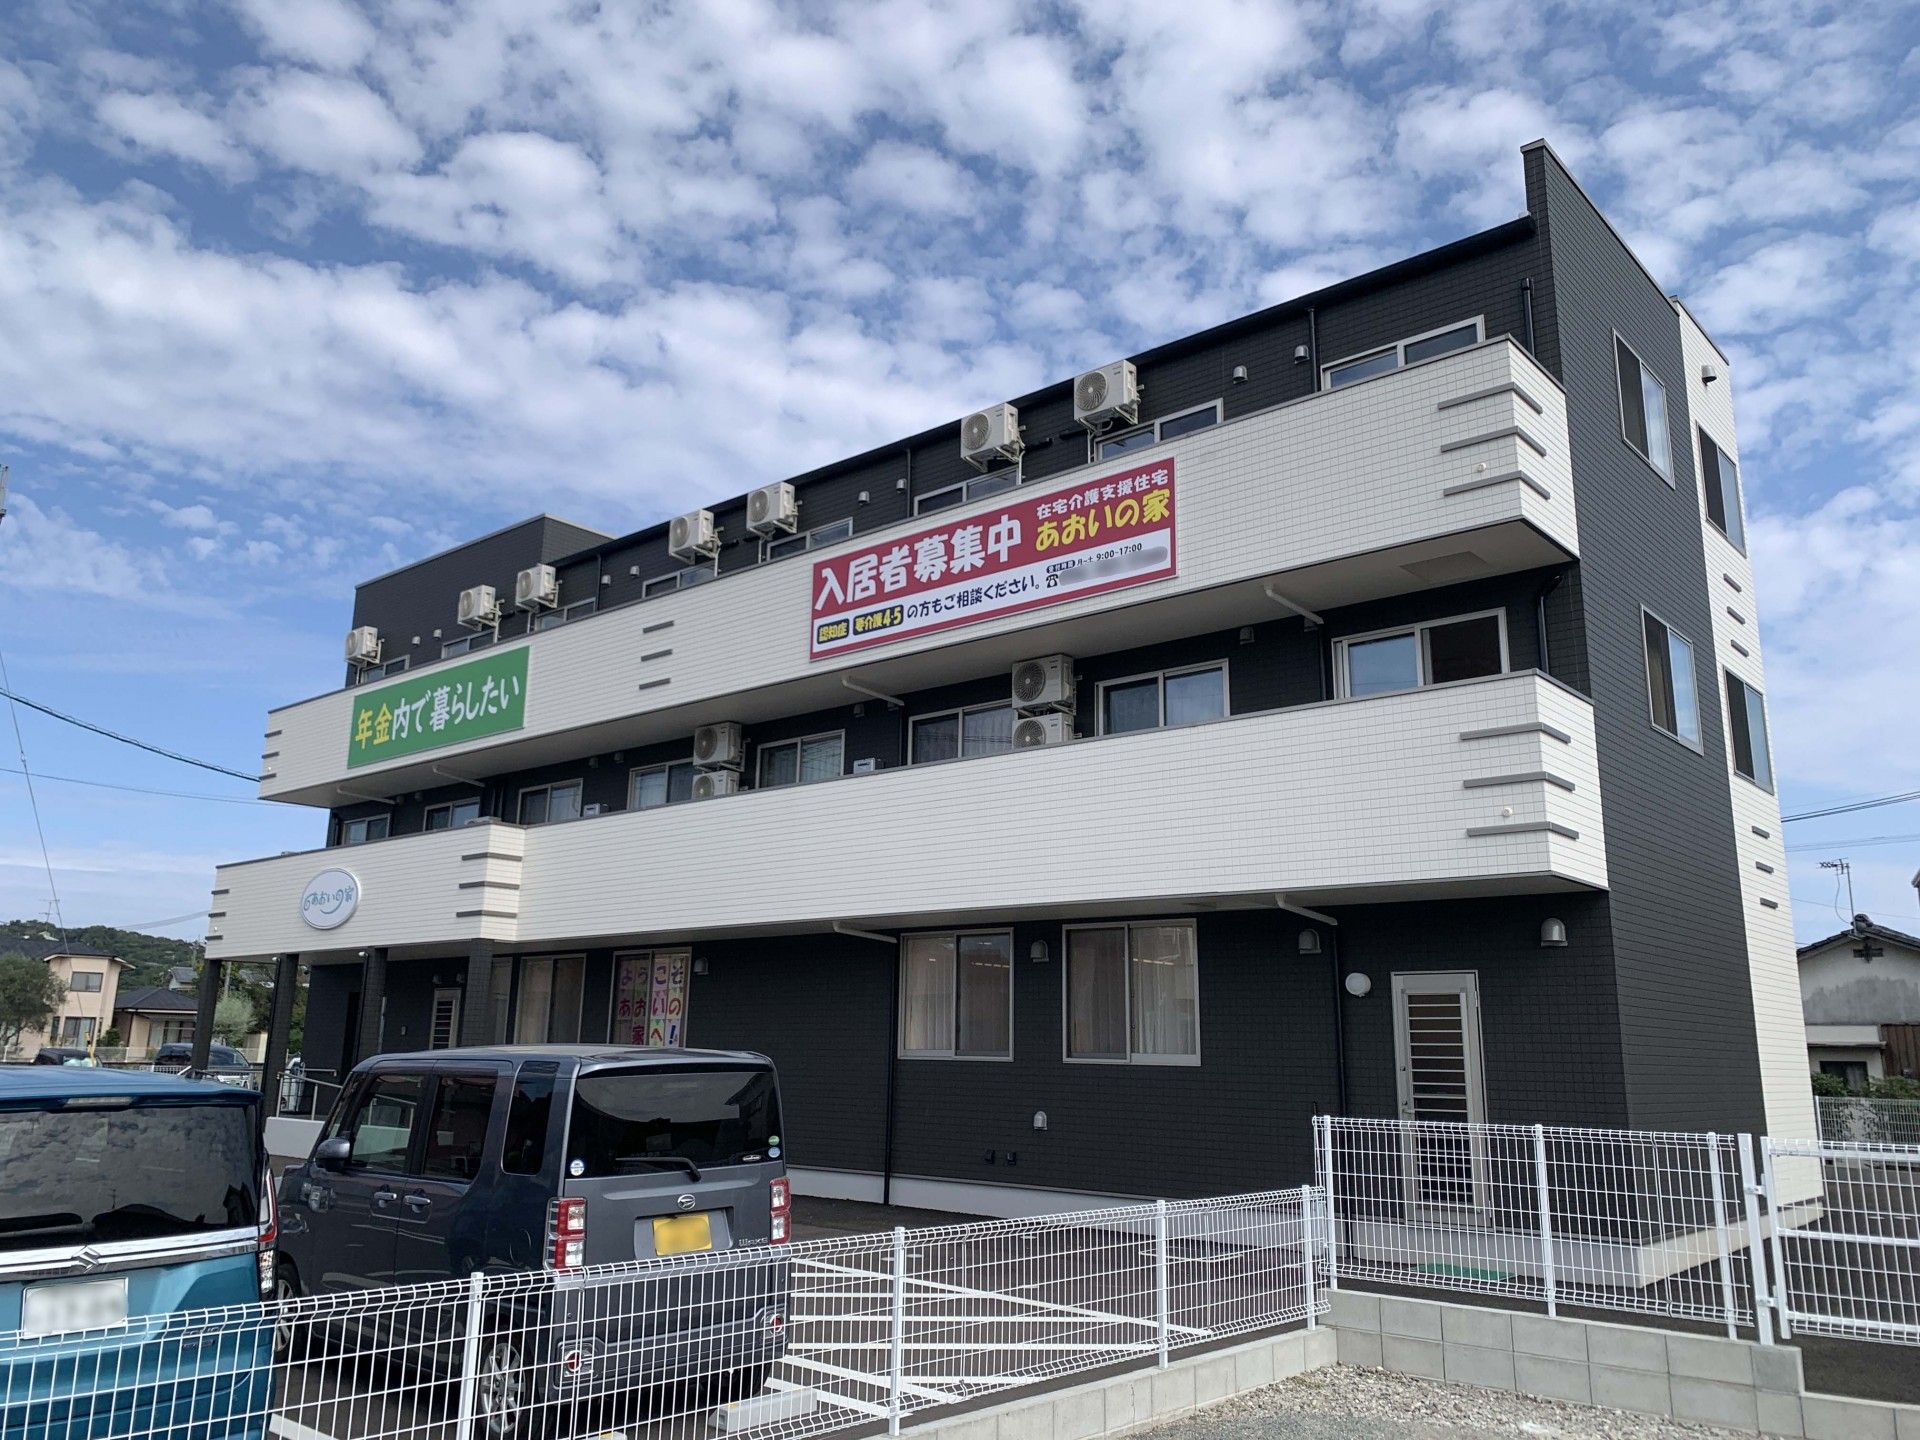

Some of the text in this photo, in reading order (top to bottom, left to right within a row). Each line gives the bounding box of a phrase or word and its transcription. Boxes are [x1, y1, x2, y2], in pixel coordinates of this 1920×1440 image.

[1035, 488, 1170, 551] あおいの家
[1036, 469, 1168, 519] 在宅介護支援住宅
[814, 515, 1021, 611] 入居者募集中
[907, 575, 1040, 619] の方もご相談ください。
[355, 675, 520, 749] 年金内で暮らしたい
[618, 997, 681, 1018] あおいの
